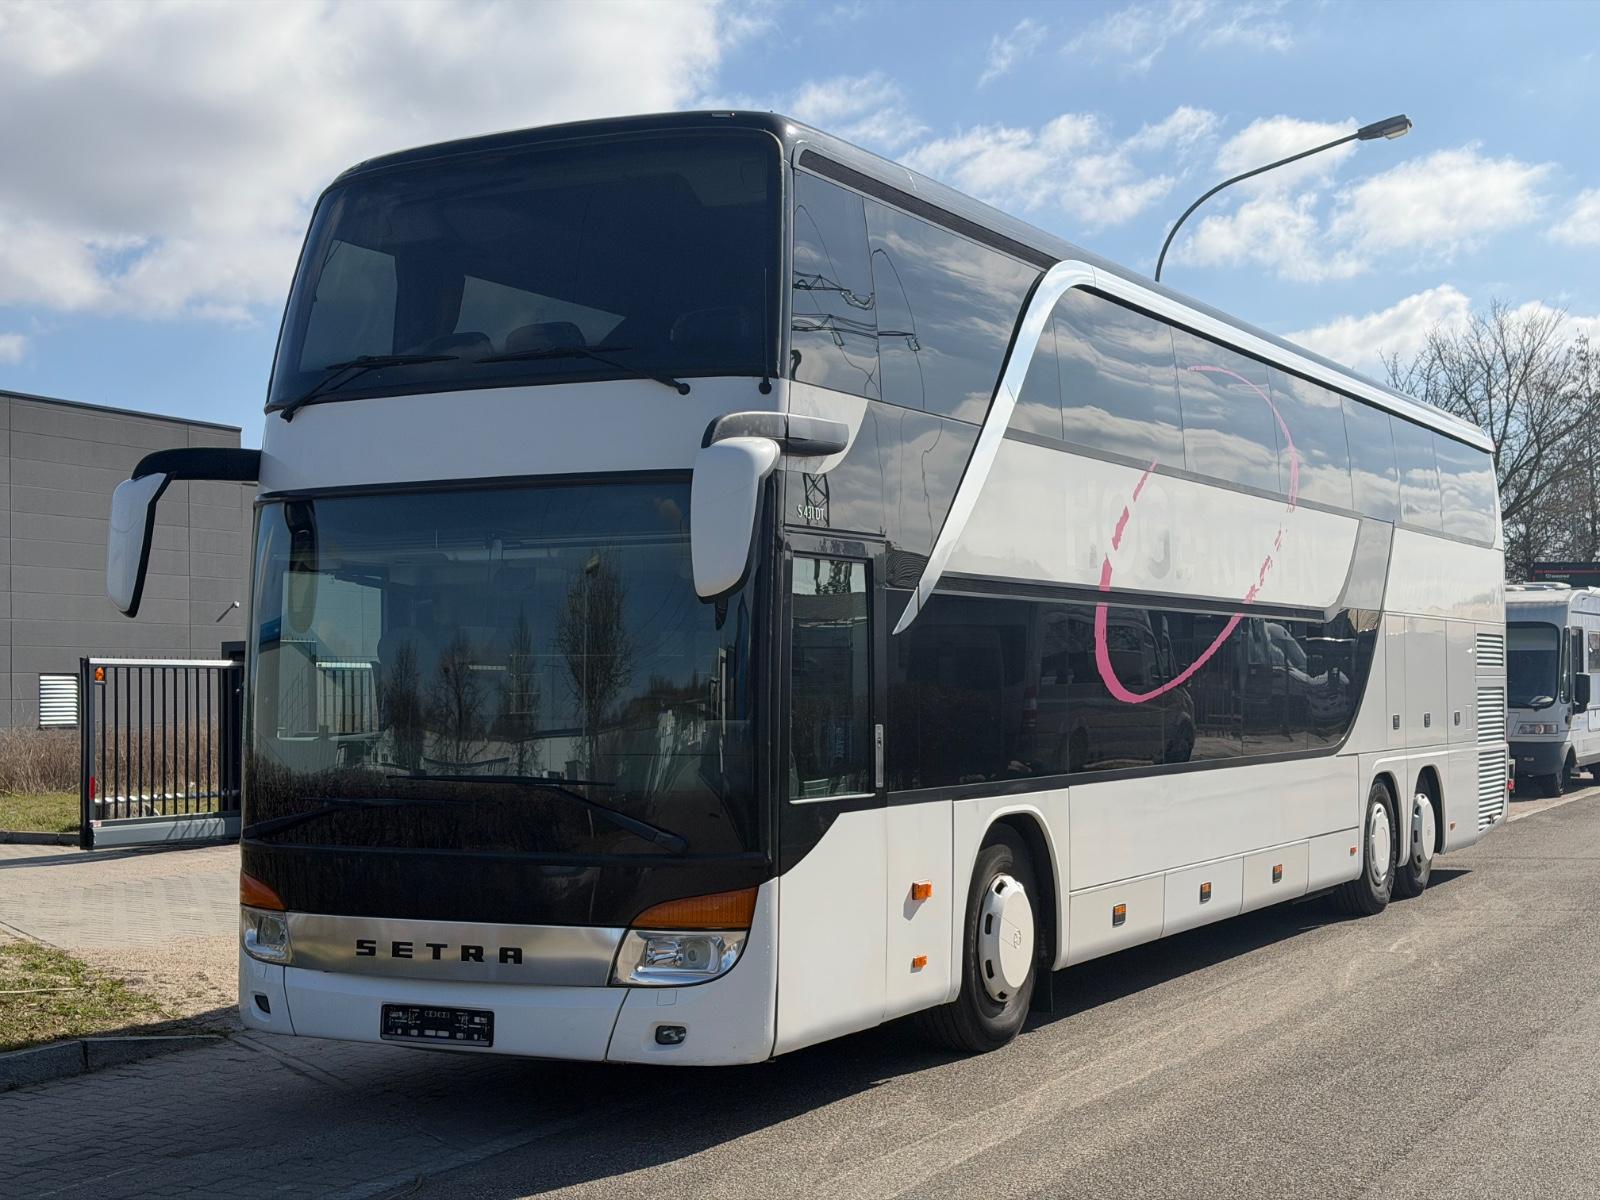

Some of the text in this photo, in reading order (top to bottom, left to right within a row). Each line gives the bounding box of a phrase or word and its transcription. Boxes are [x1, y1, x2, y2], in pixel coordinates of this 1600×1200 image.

[797, 504, 803, 518] S
[815, 507, 825, 520] DT
[356, 939, 523, 965] SETRA
